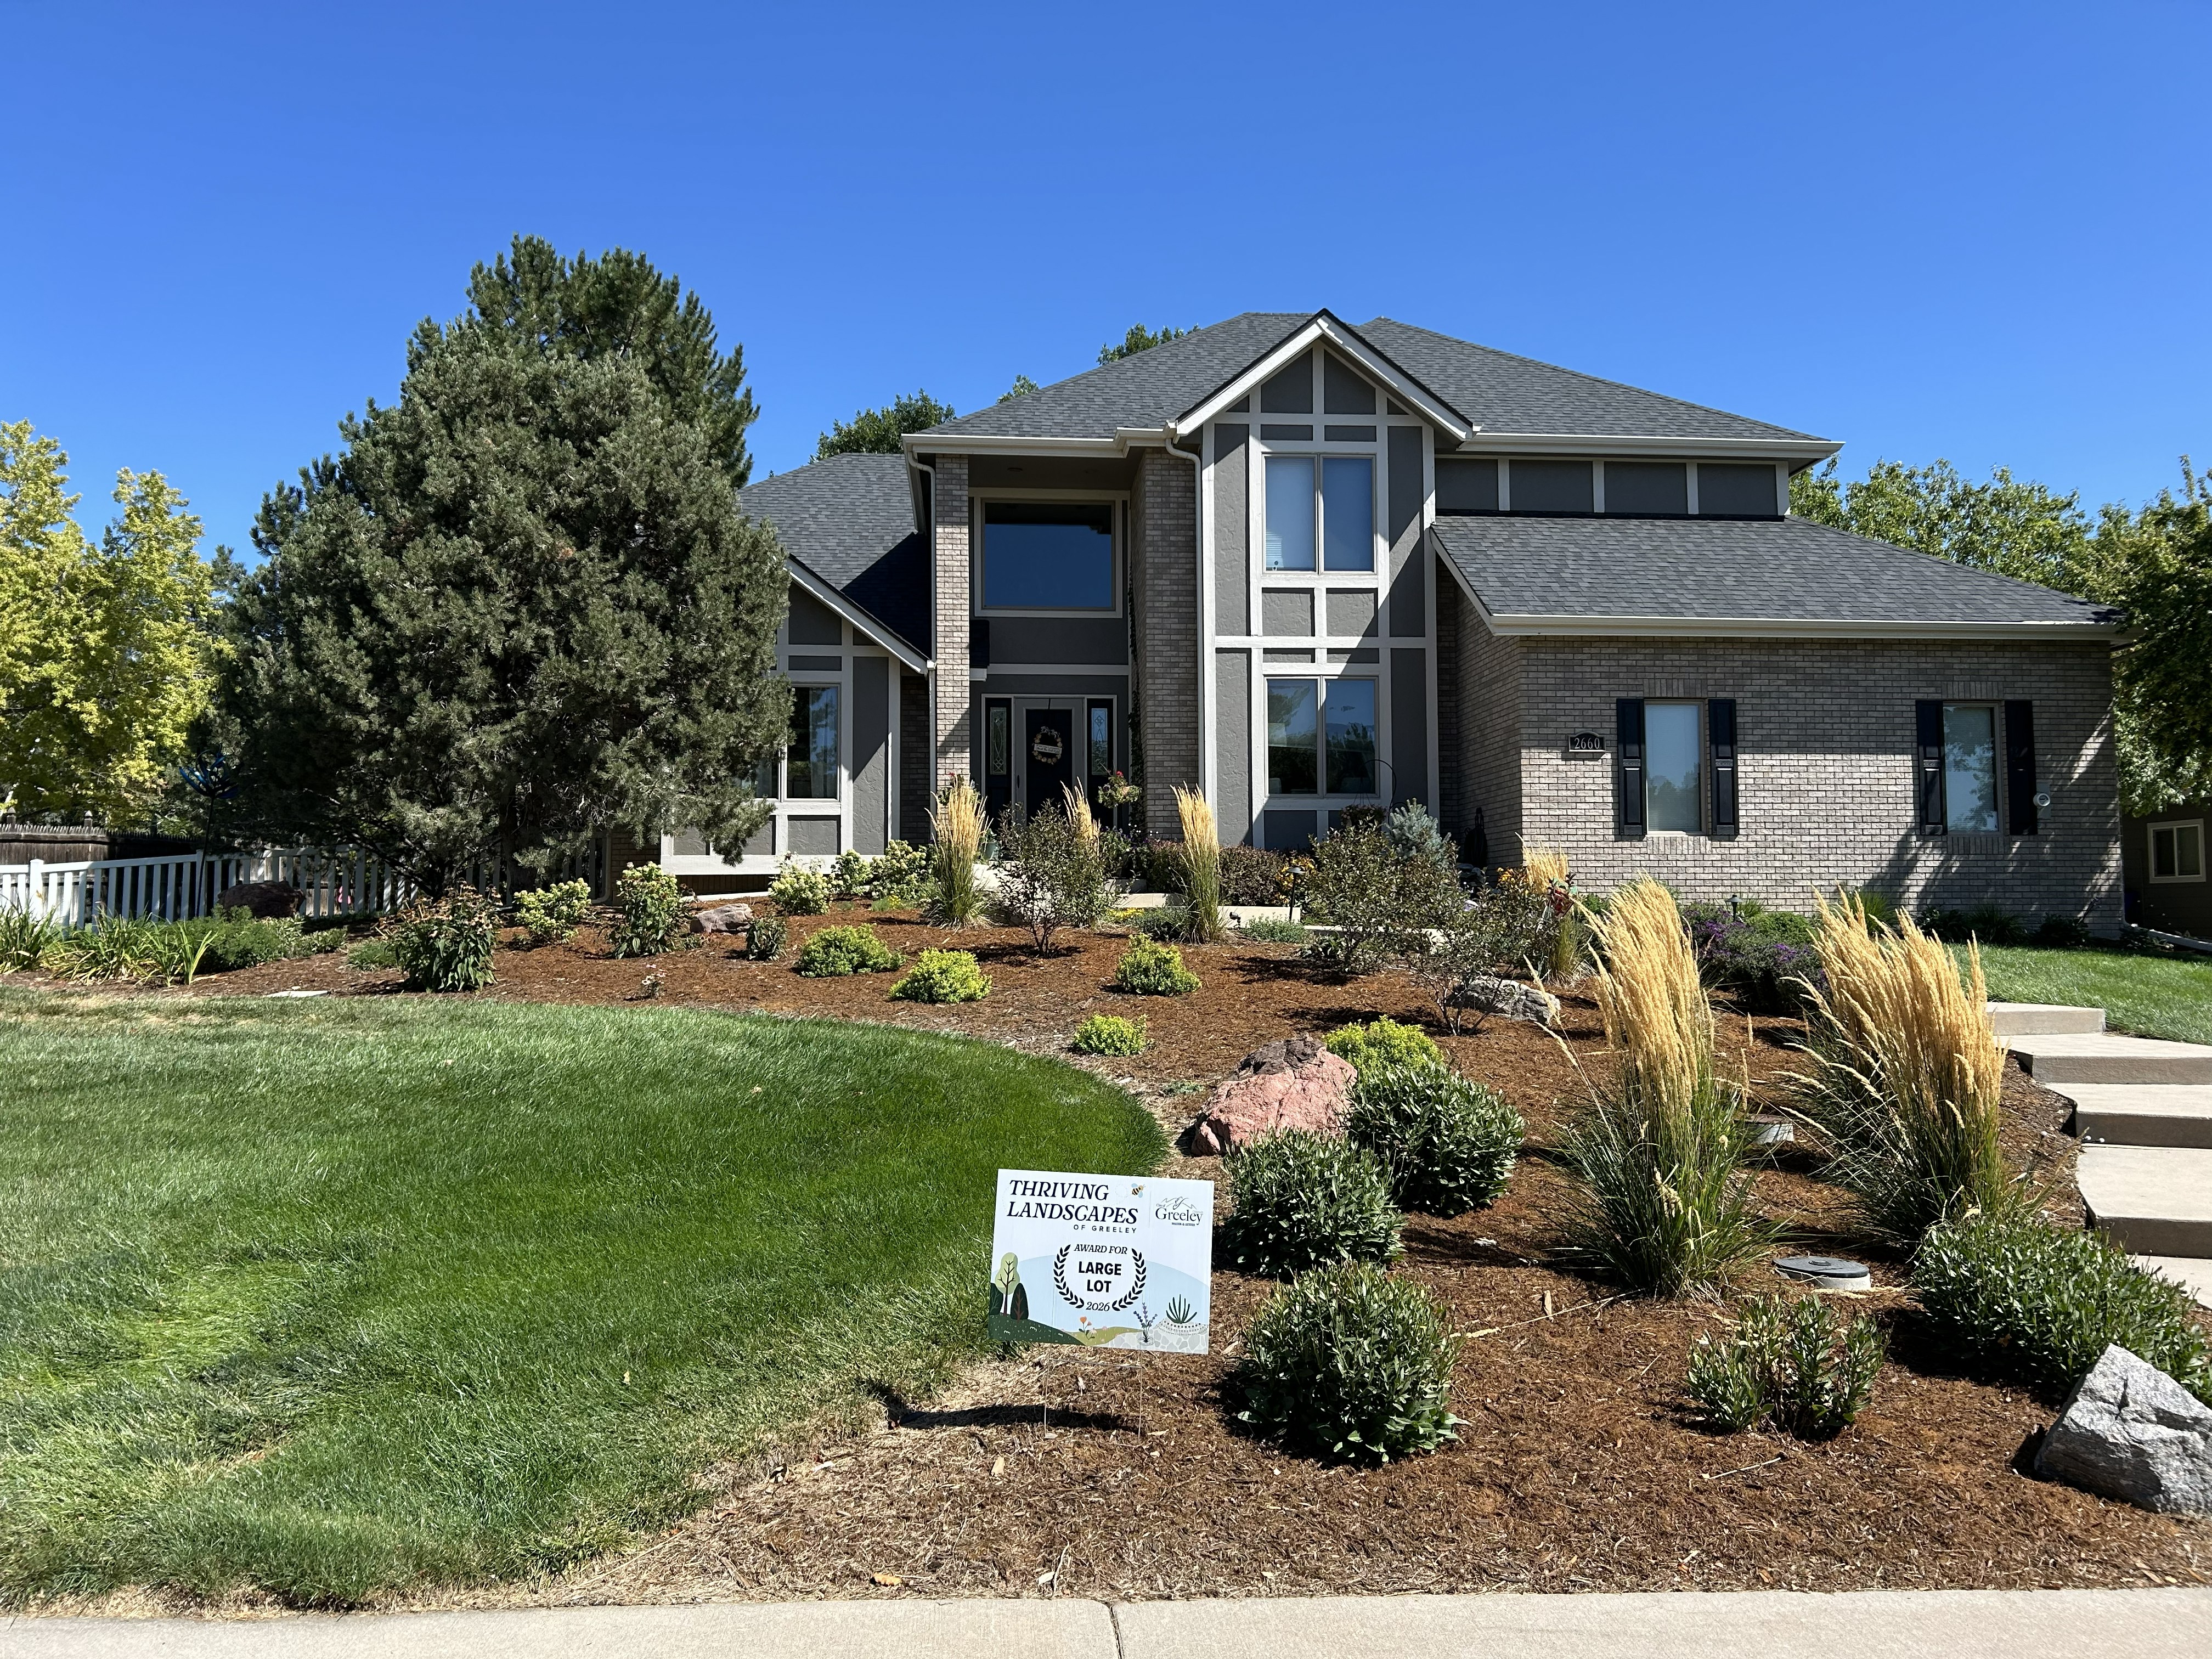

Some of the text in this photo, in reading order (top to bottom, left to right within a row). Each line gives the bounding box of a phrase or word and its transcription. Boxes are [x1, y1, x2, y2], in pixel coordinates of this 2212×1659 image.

[1574, 737, 1600, 749] 2660
[1009, 1180, 1109, 1201] THRIVING
[1006, 1201, 1139, 1224] LANDSCAPES
[1155, 1207, 1203, 1226] Greeley
[1092, 1225, 1137, 1234] GREELEY
[1074, 1244, 1128, 1255] AWARD FOR
[1078, 1261, 1122, 1276] LARGE
[1087, 1279, 1112, 1293] LOT
[1086, 1302, 1110, 1312] 2026
